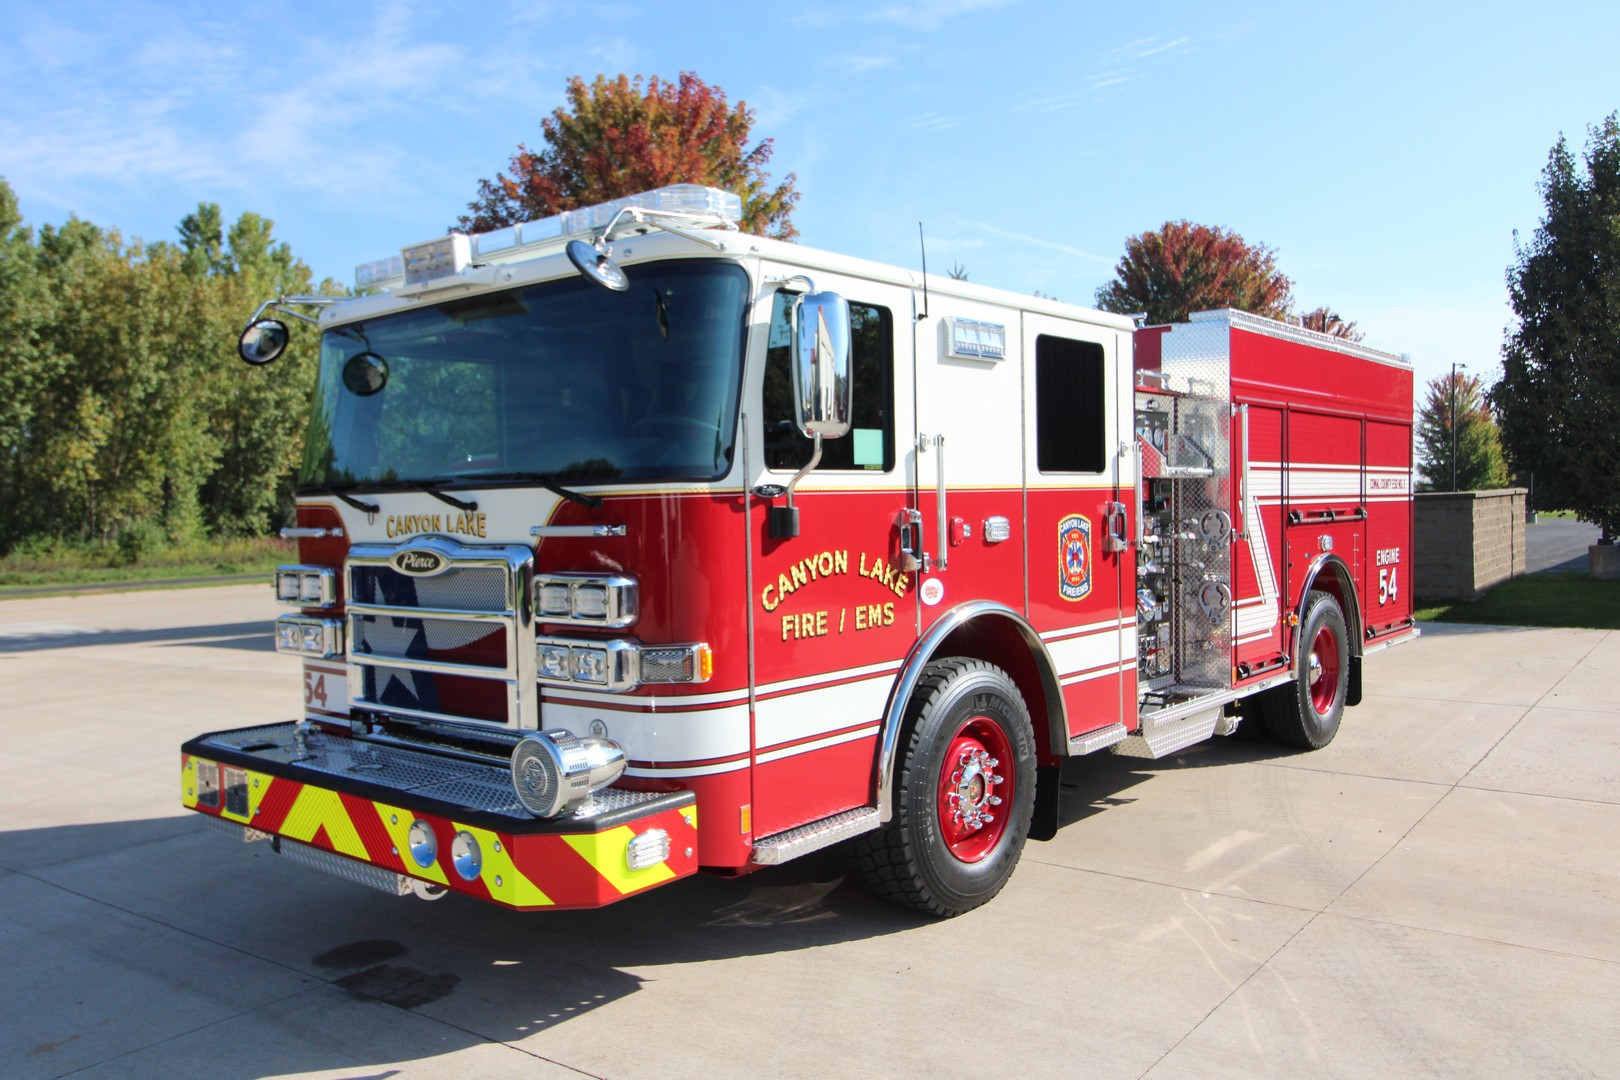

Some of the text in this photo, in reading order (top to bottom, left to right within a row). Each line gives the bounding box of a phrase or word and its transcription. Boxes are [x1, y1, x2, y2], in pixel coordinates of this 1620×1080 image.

[386, 513, 487, 538] CANYON LAKE
[401, 552, 435, 570] Pierce
[1376, 547, 1400, 566] ENGINE
[761, 550, 909, 611] CANYON LAKE
[1379, 567, 1398, 606] 54
[781, 610, 828, 641] FIRE
[855, 602, 895, 630] EMS
